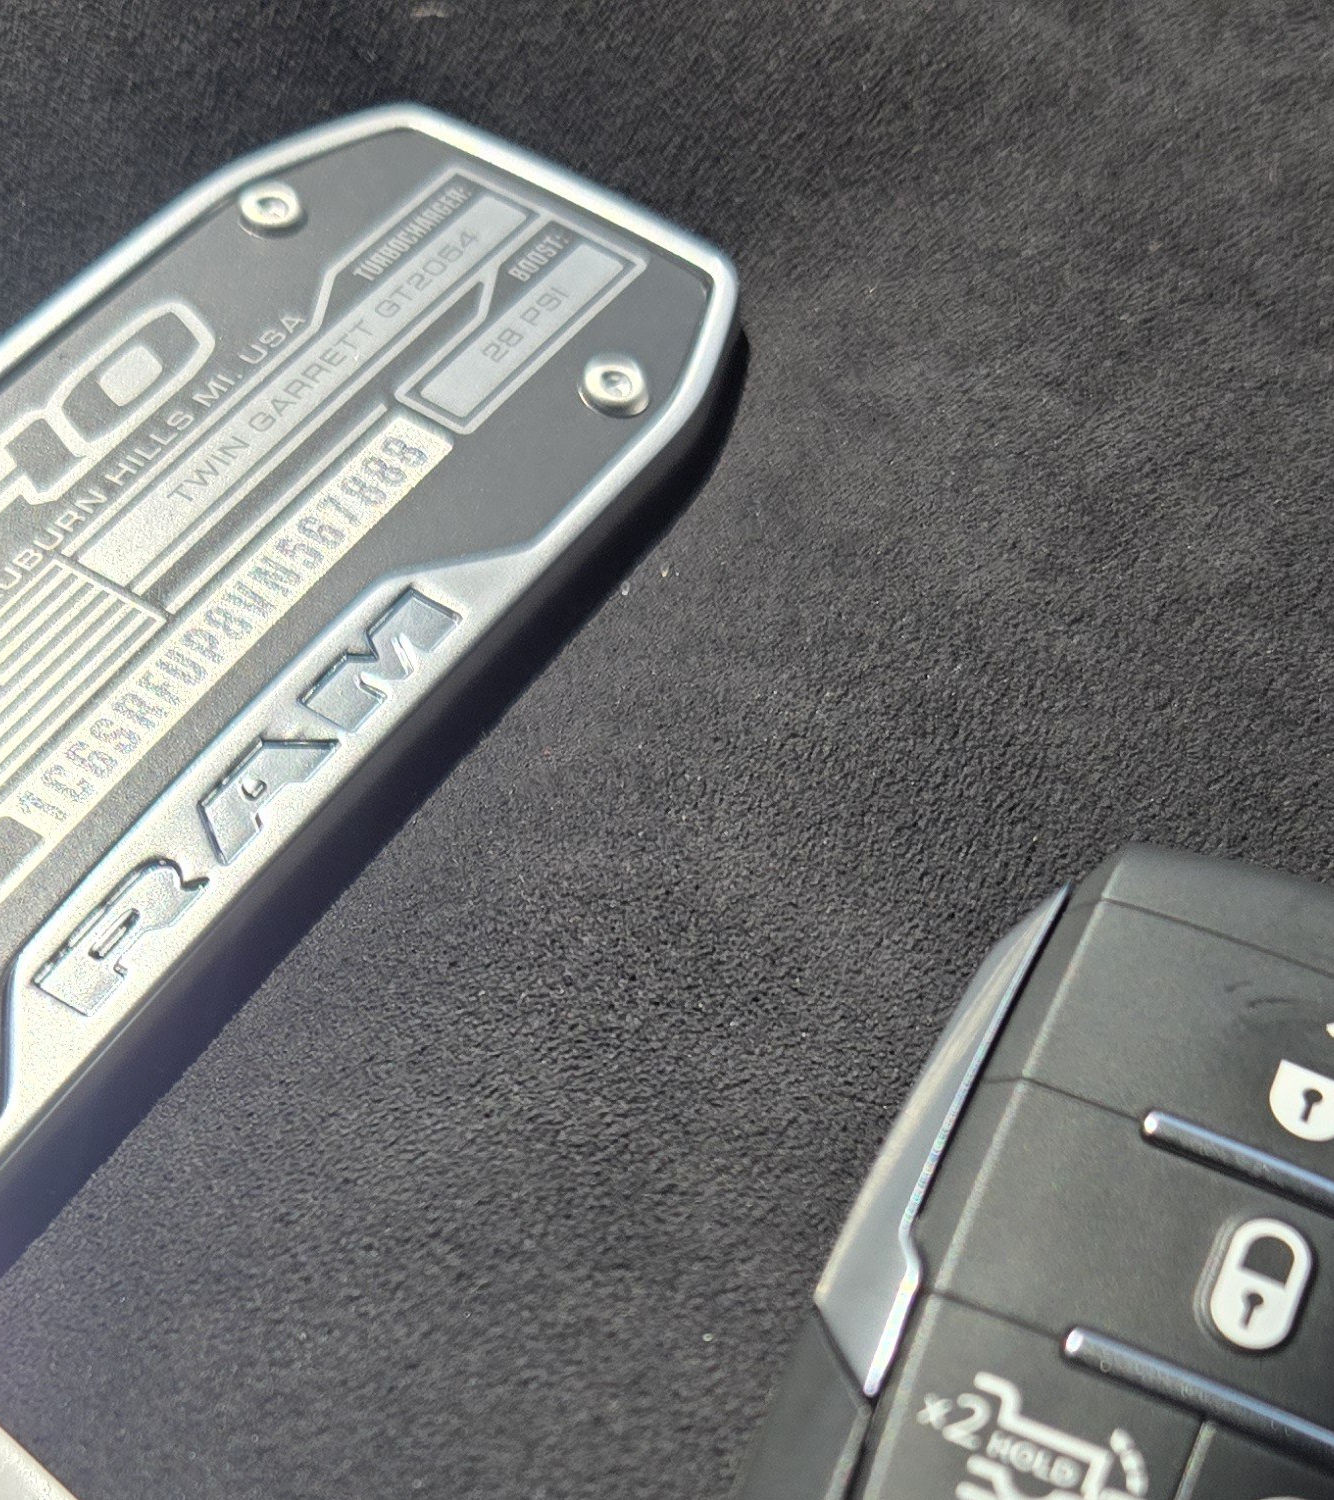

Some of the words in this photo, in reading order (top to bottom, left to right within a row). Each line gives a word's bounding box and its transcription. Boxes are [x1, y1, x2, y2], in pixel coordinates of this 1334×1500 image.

[352, 182, 474, 283] TURBOCHARGER:
[508, 230, 572, 282] BOOST:
[166, 434, 250, 505] TWIN
[247, 317, 373, 435] GARRETT
[374, 228, 482, 320] GT2054
[479, 325, 525, 365] 28
[520, 284, 572, 329] PSI
[104, 405, 194, 487] HILLS
[192, 367, 243, 409] MI.
[240, 312, 307, 366] USA
[29, 584, 465, 1018] RAM
[986, 1431, 1082, 1488] HOLD
